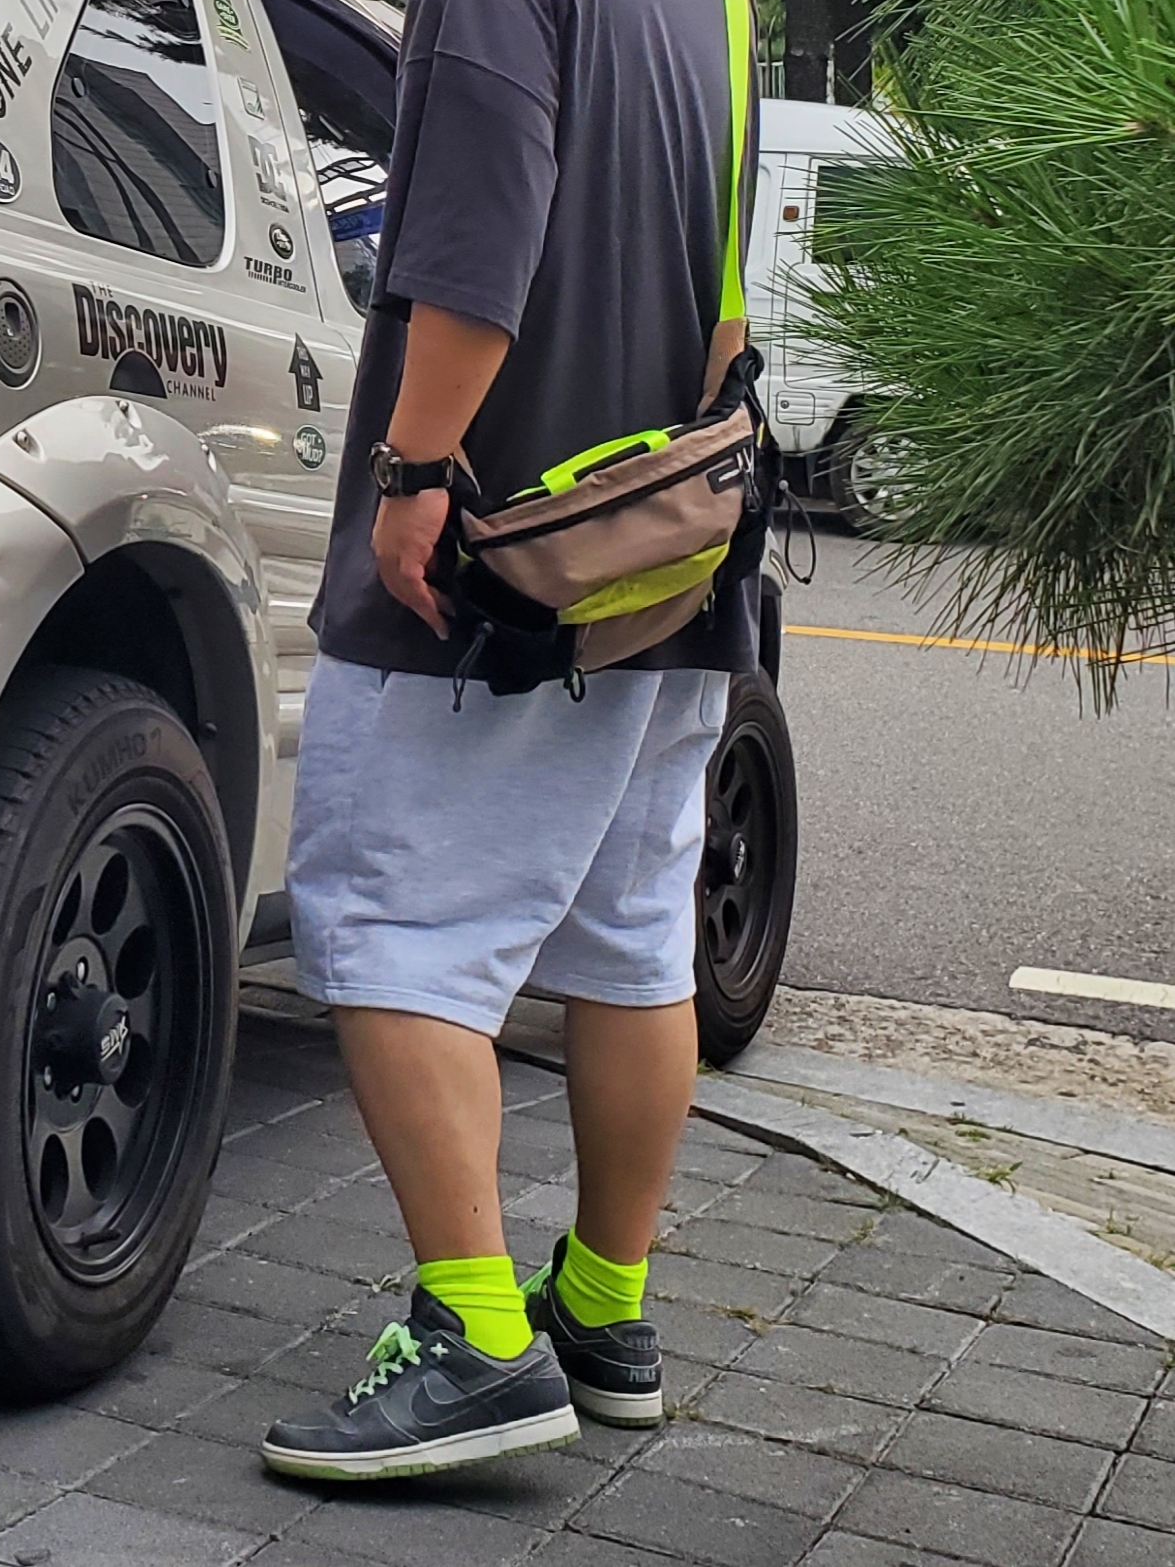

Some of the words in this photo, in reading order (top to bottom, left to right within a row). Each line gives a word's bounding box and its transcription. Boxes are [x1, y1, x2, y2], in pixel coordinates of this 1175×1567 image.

[243, 256, 293, 285] TURBO
[90, 281, 114, 299] THE
[166, 380, 216, 402] CHANNEL
[303, 384, 314, 405] UP
[67, 732, 148, 816] KUMHO
